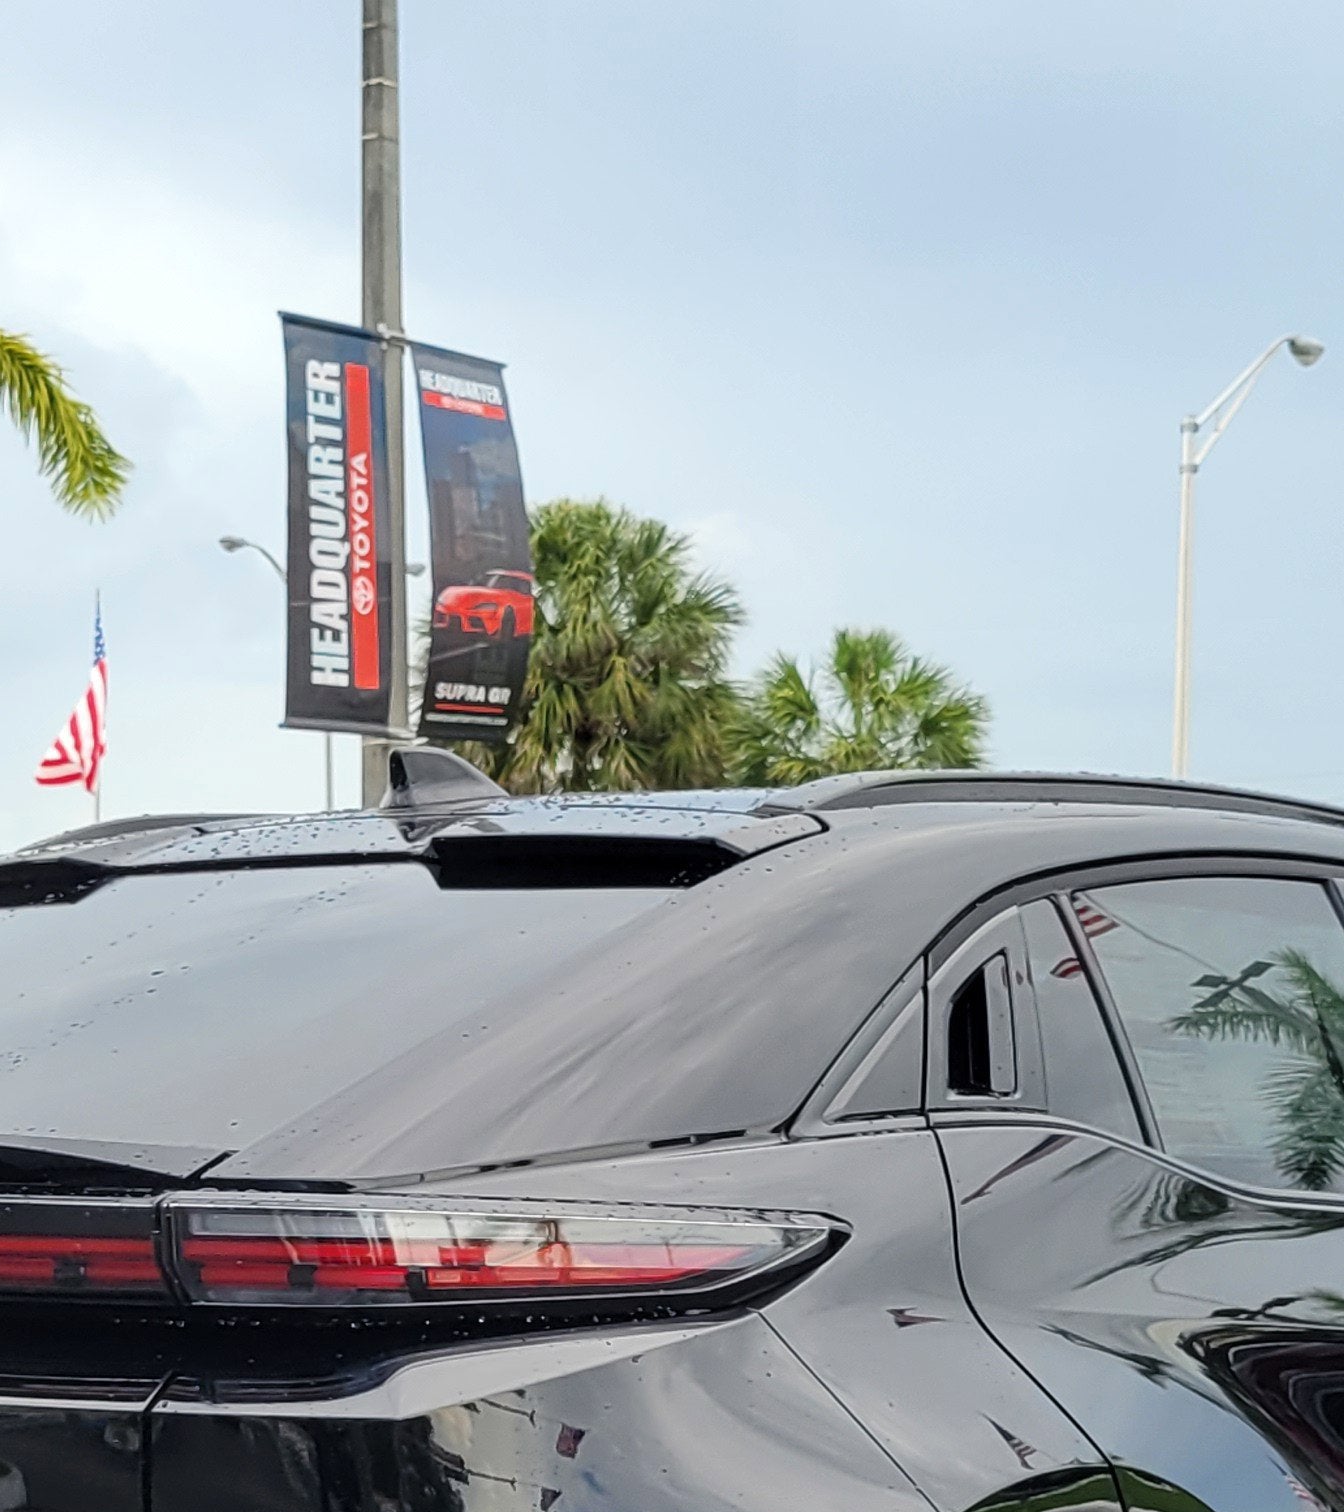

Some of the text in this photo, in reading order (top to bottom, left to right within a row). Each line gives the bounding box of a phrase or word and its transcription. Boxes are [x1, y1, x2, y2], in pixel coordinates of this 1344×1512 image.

[305, 358, 351, 688] HEADQUARTER
[350, 452, 371, 574] TOYOTA
[435, 682, 486, 702] SUPRA
